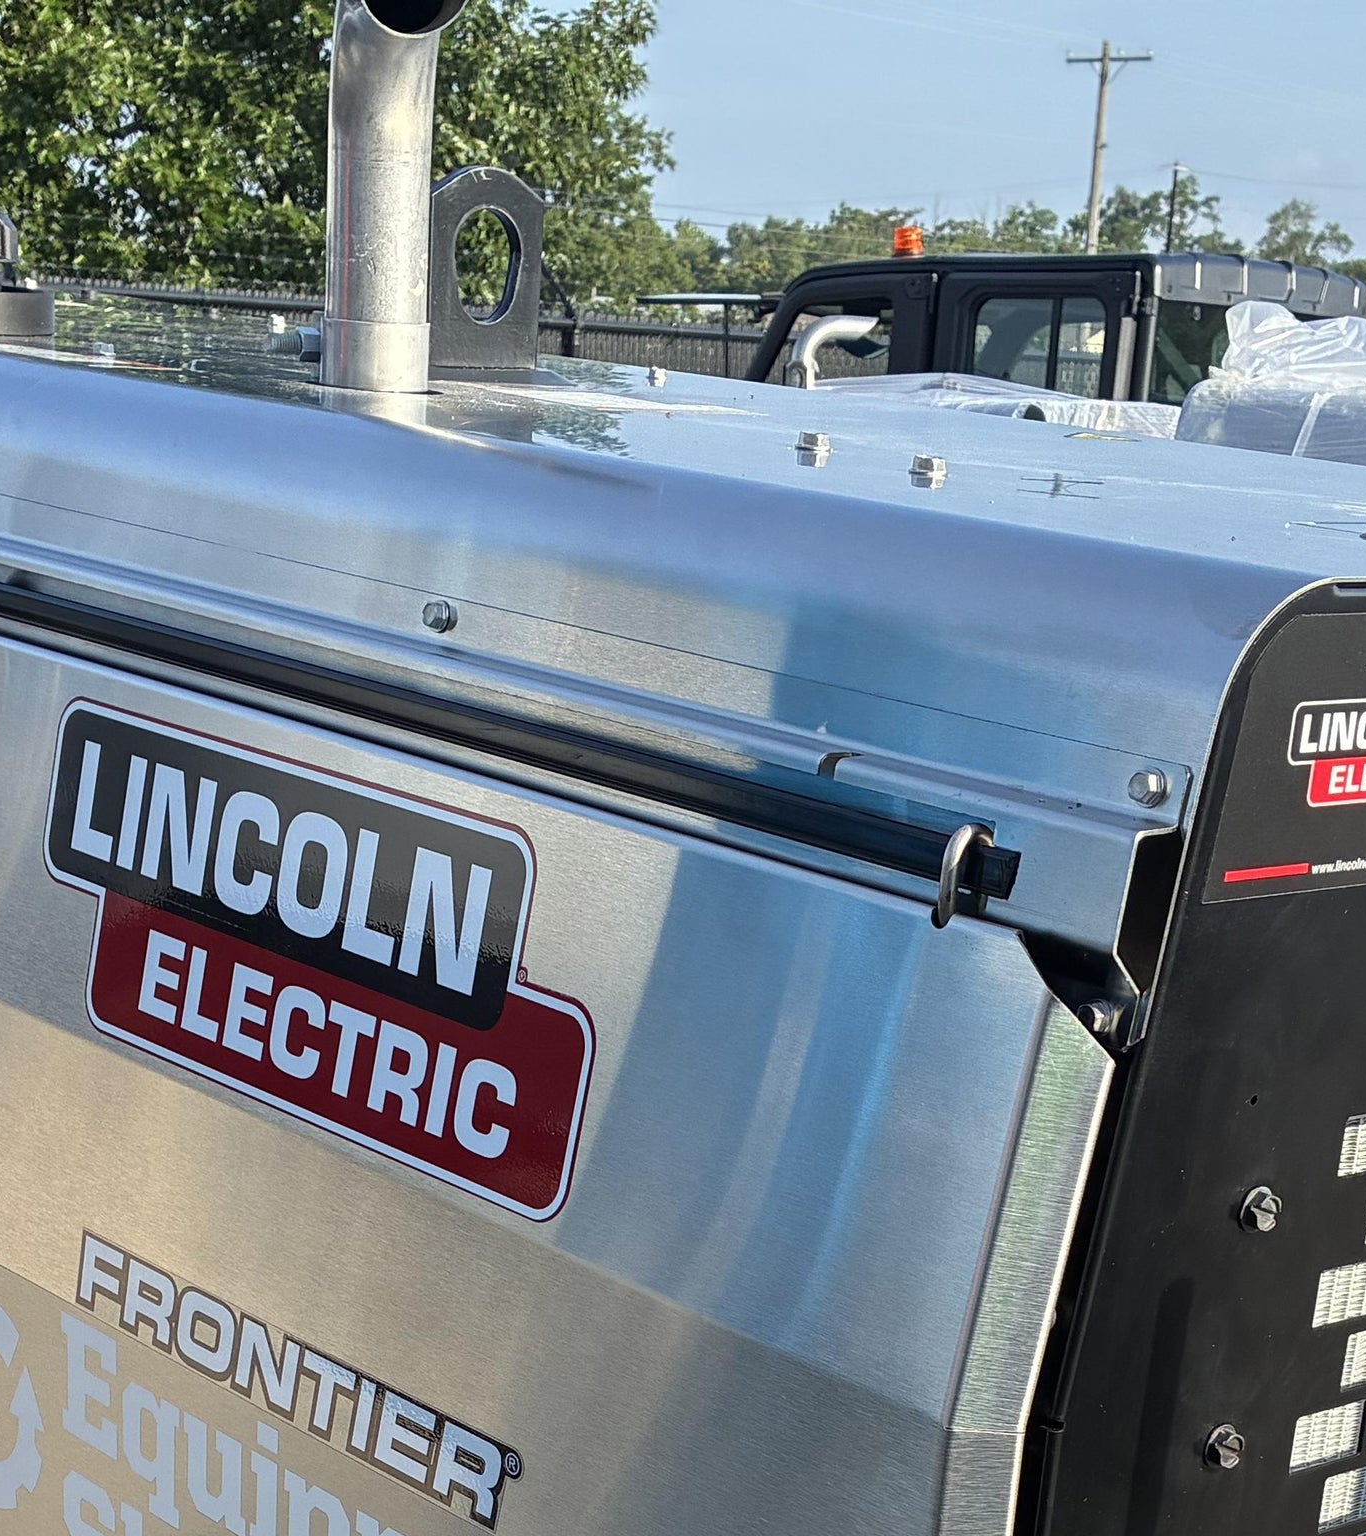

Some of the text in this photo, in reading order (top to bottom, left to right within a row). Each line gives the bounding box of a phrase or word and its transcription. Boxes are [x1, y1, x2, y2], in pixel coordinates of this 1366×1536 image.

[70, 739, 493, 997] LINCOLN
[137, 929, 517, 1159] ELECTRIC
[78, 1233, 511, 1523] FRONTIER
